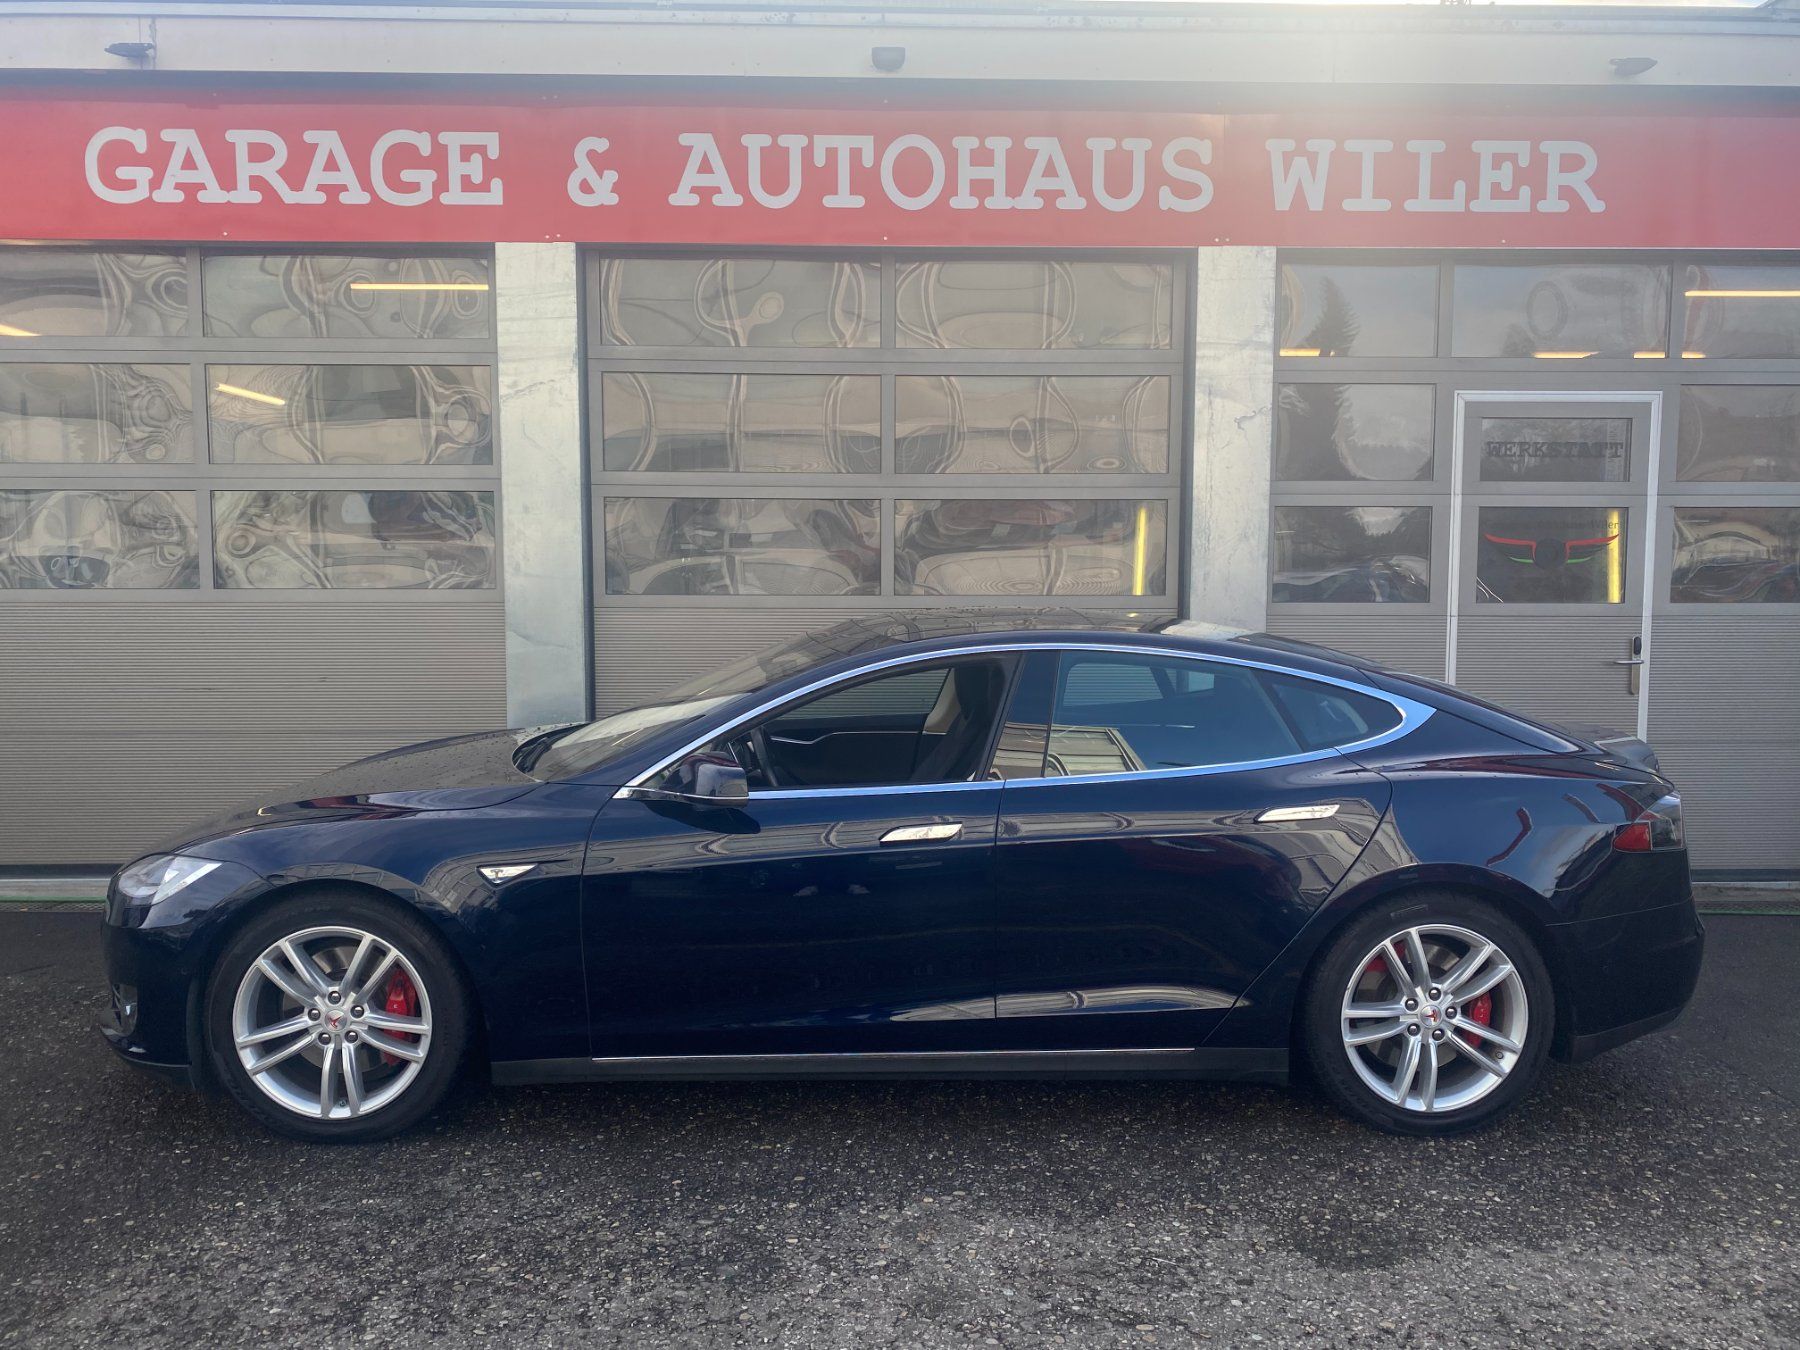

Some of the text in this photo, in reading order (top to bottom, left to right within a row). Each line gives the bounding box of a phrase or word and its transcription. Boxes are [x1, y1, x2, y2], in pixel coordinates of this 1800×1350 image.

[84, 125, 1607, 213] GARAGE & AUTOHAUS WILER
[1487, 441, 1623, 458] WERKSTATT
